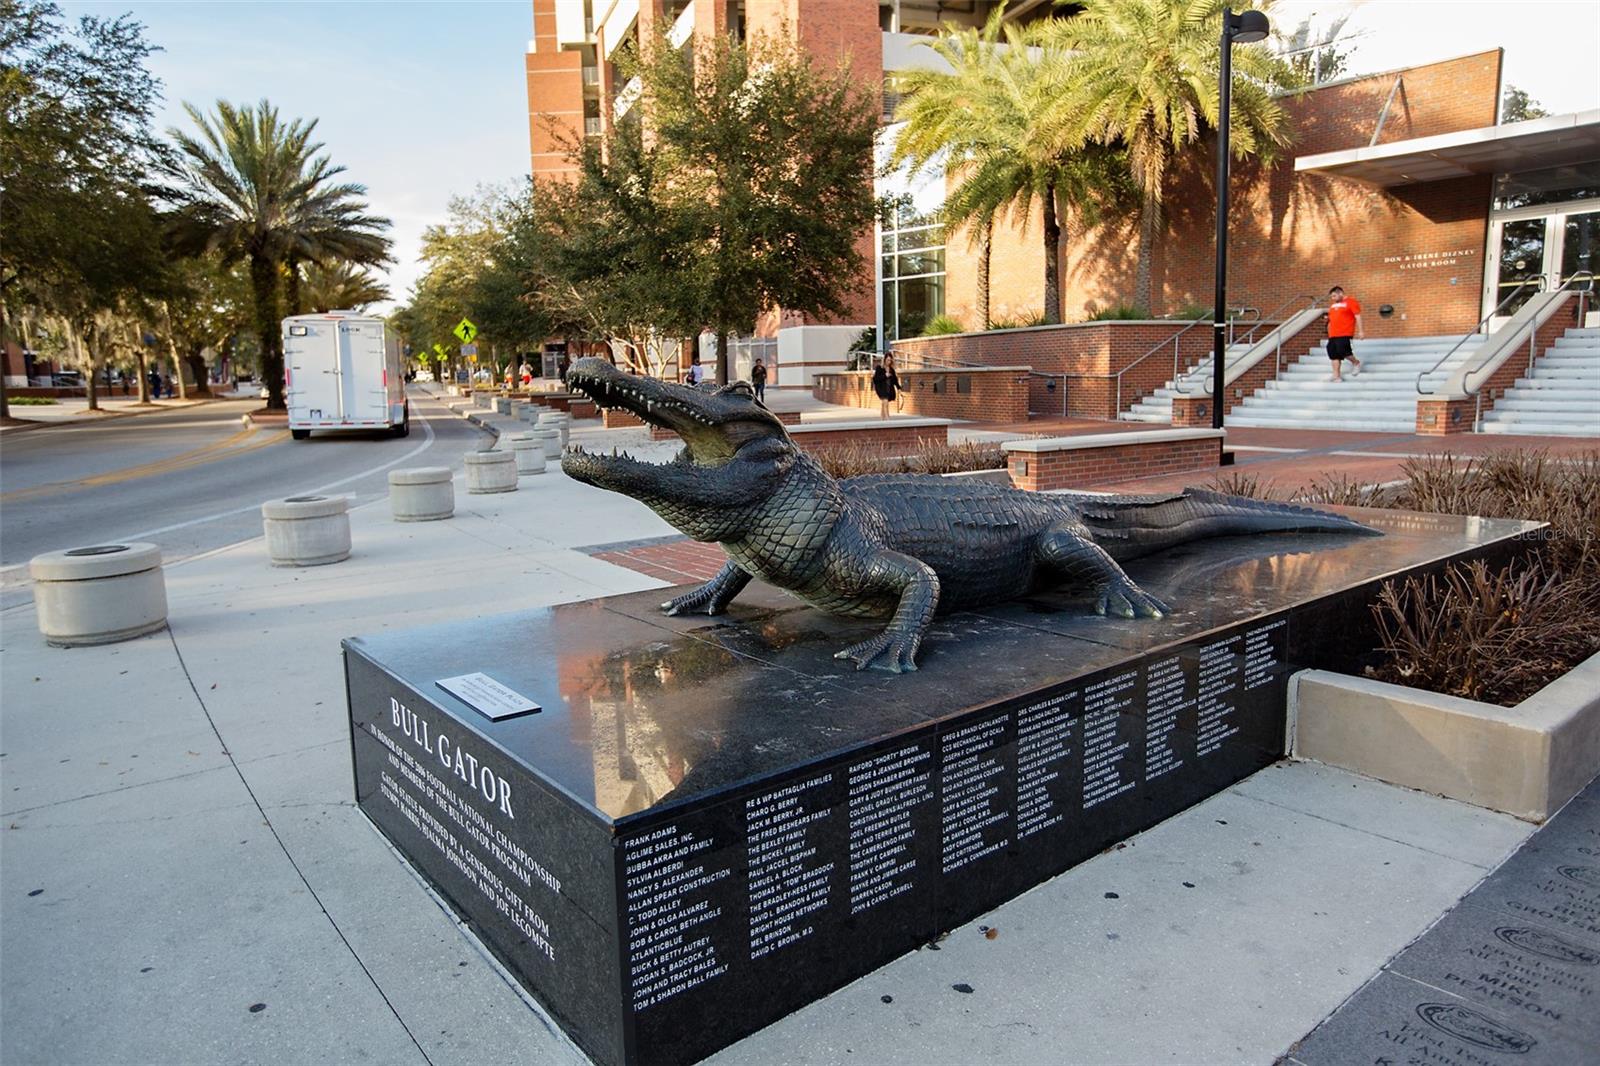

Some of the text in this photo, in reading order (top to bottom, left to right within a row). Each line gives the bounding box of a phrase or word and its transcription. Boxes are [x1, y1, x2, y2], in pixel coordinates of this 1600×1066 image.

[390, 696, 514, 820] BULL GATOR
[389, 753, 531, 886] AND MEMBERS OF THE BULL GATOR PROGRAM
[396, 746, 402, 757] OF
[404, 751, 414, 768] THE
[427, 771, 456, 804] FOOTBALL
[459, 799, 494, 837] NATIONAL
[496, 831, 560, 892] CHAMPIONSHIP
[625, 826, 677, 848] FRANK ADAMS
[382, 771, 549, 937] GATOR STATUE PROVIDED BY A GENEROUS GIFT FROM
[626, 846, 653, 860] AGLIME
[627, 839, 713, 874] BUBBA AKRA AND FAMILY
[422, 823, 445, 853] HJALMA
[446, 847, 477, 883] JOHNSON
[479, 879, 495, 900] AND
[496, 895, 509, 916] JOE
[511, 909, 554, 960] LECOMPTE
[627, 861, 684, 887] SYLVIA ALBERDI
[628, 885, 652, 899] NANCY
[662, 866, 703, 887] ALEXANDER
[629, 870, 730, 911] ALLAN SPEAR CONSTRUCTION
[630, 900, 708, 938] JOHN & OLGA ALVAREZ
[630, 907, 721, 950] BOB & CAROL BETH ANGLE
[638, 908, 658, 921] TODD
[659, 899, 681, 913] ALLEY
[632, 935, 682, 961] ATLANTICBLUE
[632, 937, 710, 975] BUCK & BETTY AUTREY
[633, 958, 716, 999] JOHN AND TRACY BALES
[634, 999, 649, 1010] TOM
[657, 983, 686, 1001] SHARON
[687, 976, 704, 988] BALL
[706, 964, 728, 979] FAMILY
